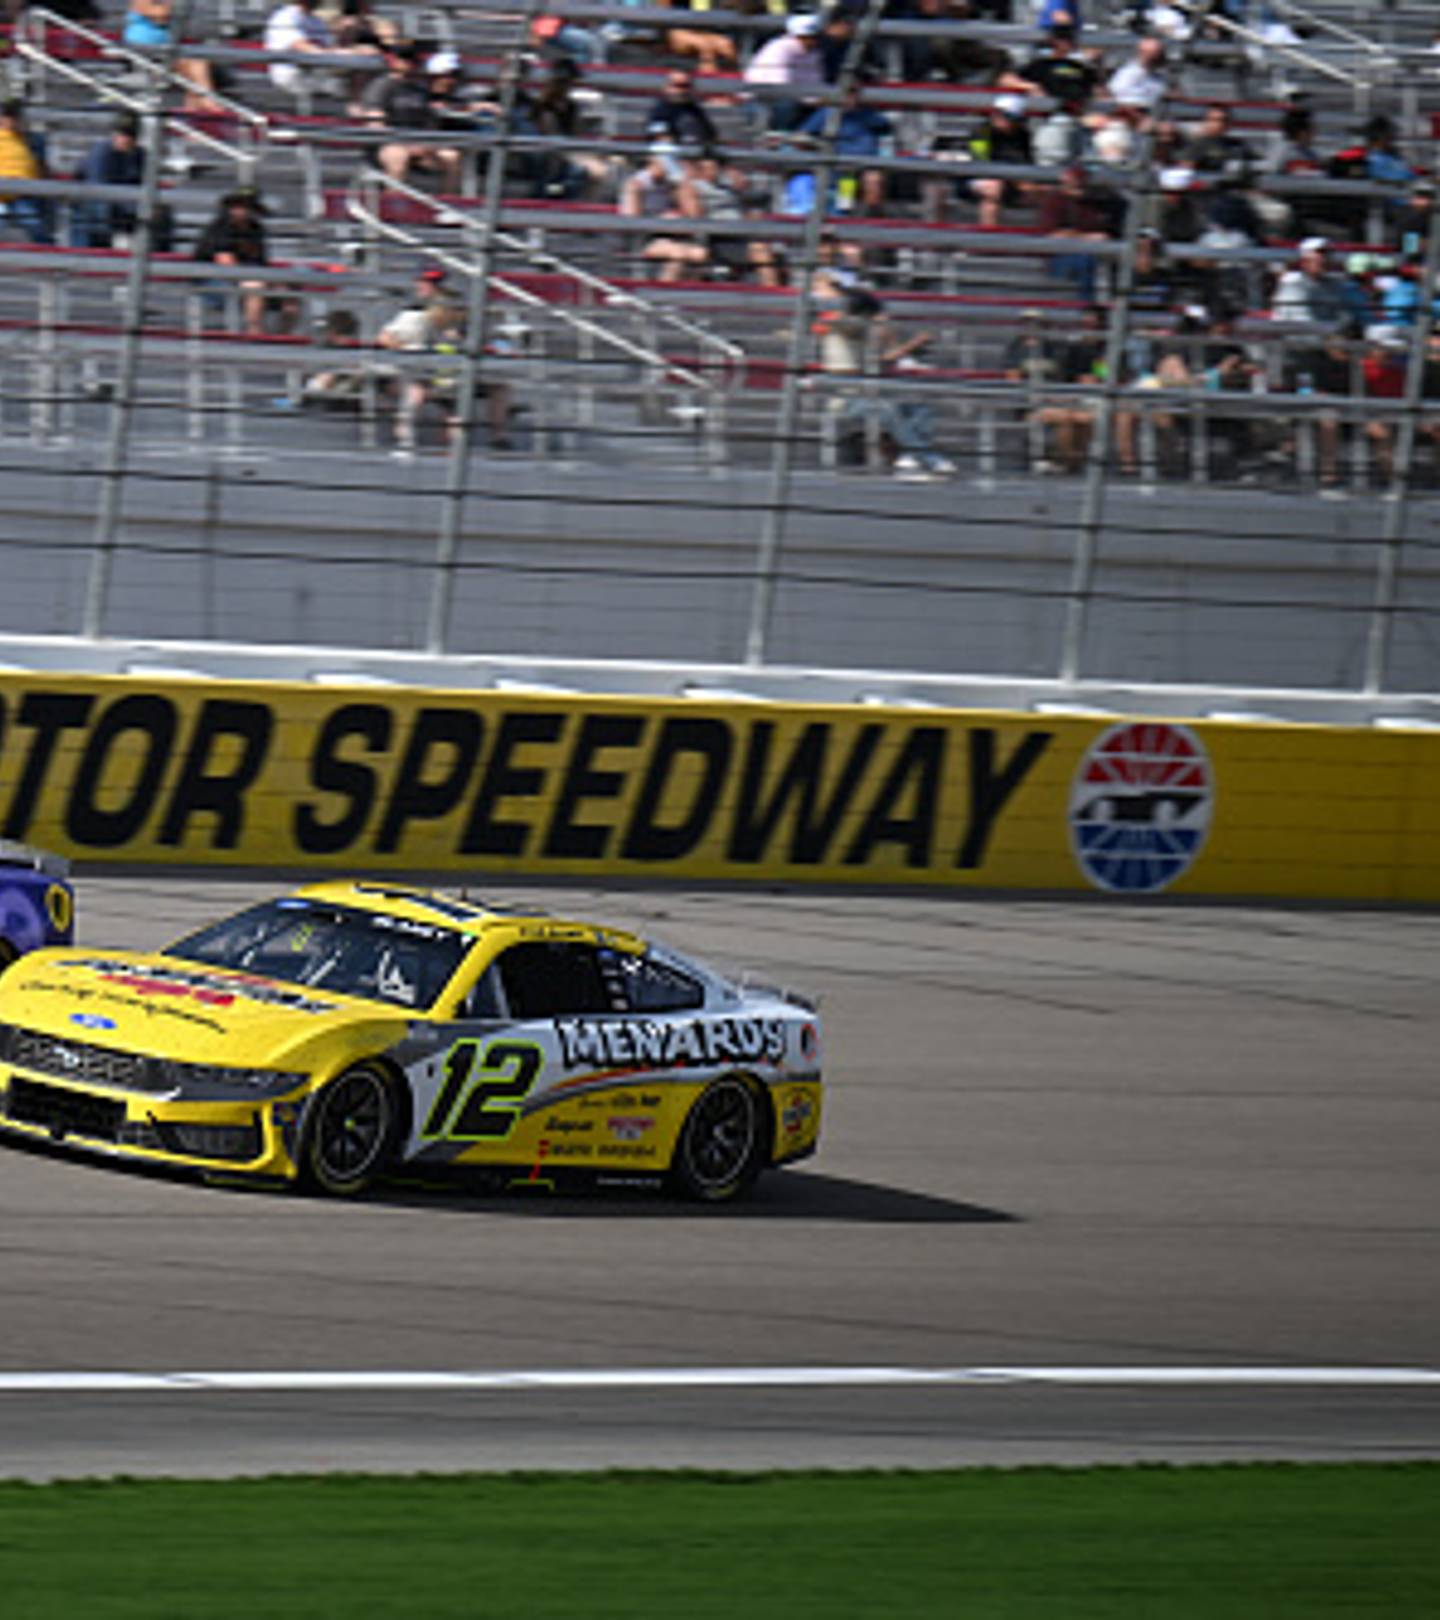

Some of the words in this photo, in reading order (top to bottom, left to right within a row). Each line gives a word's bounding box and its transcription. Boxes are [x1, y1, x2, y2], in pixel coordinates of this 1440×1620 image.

[293, 703, 1055, 871] SPEEDWAY
[421, 1036, 546, 1142] 12
[554, 1016, 788, 1070] MENARDS
